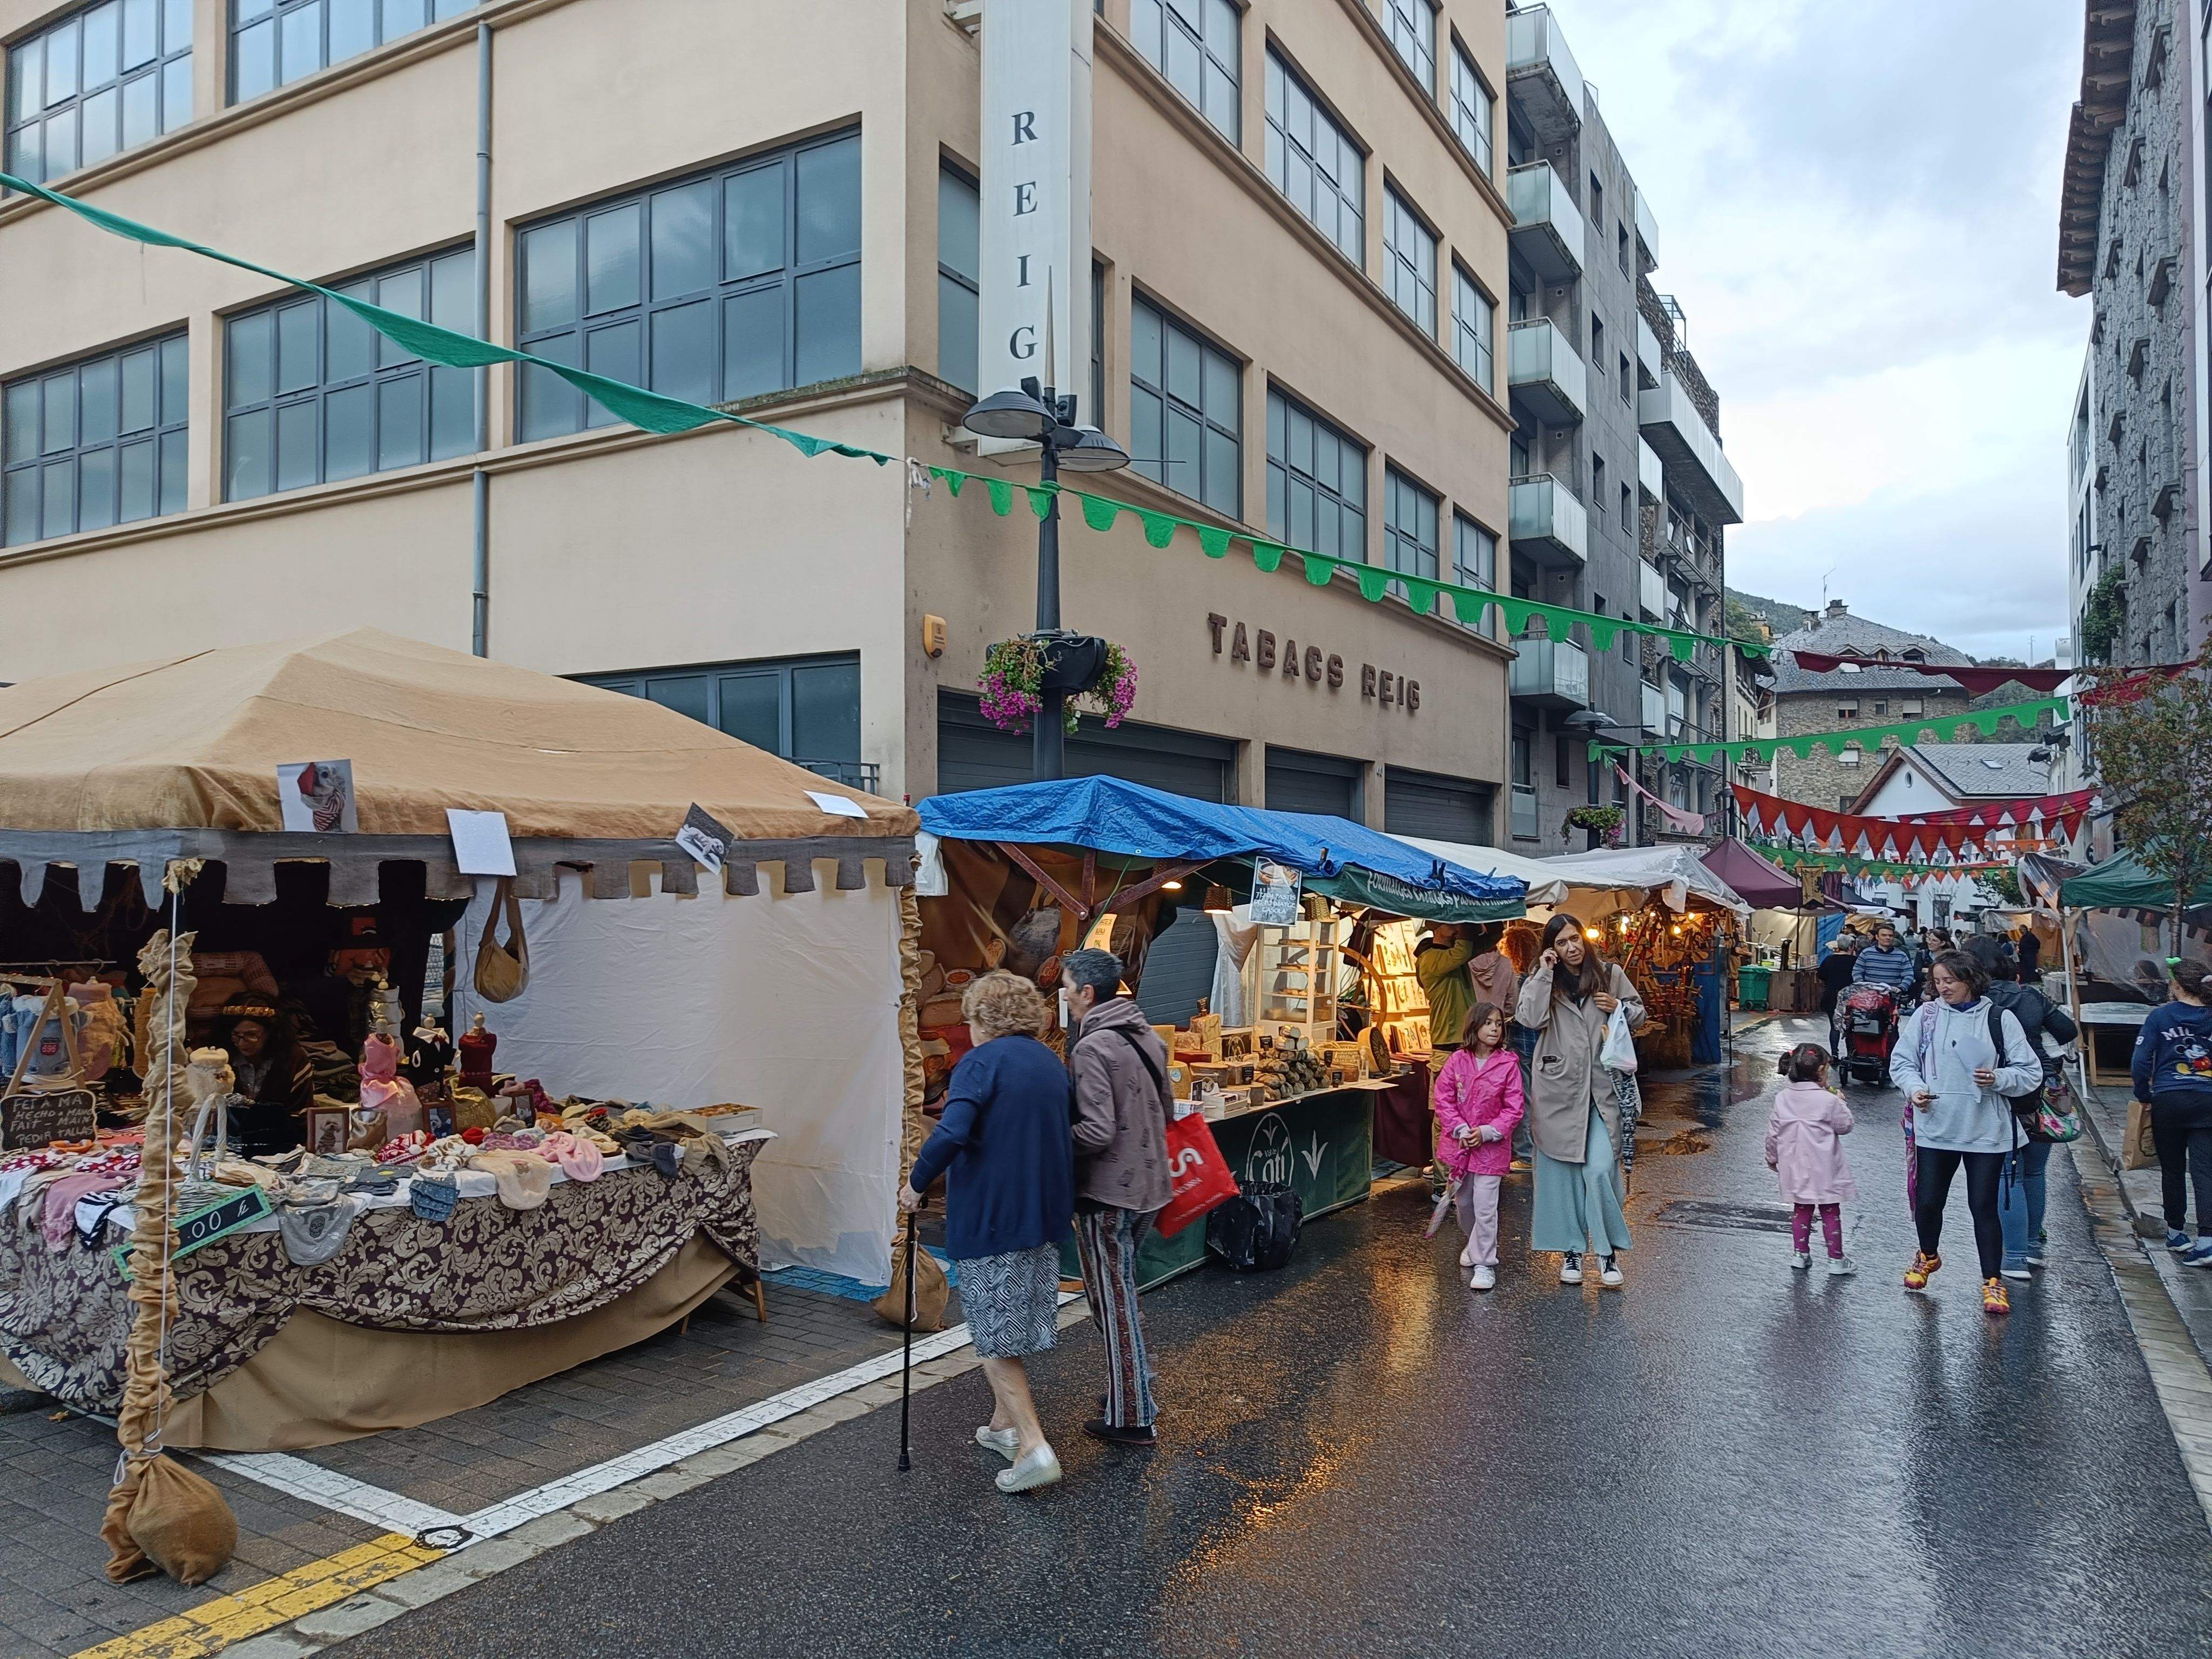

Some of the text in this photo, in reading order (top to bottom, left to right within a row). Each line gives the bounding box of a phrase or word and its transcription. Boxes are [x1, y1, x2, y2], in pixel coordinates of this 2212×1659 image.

[1009, 110, 1038, 361] REIG
[1208, 611, 1421, 710] TABACS REIG
[12, 1098, 37, 1112] FET
[15, 1110, 56, 1120] HECHO
[10, 1120, 42, 1132] FAIT
[15, 1131, 52, 1146] PEDIR
